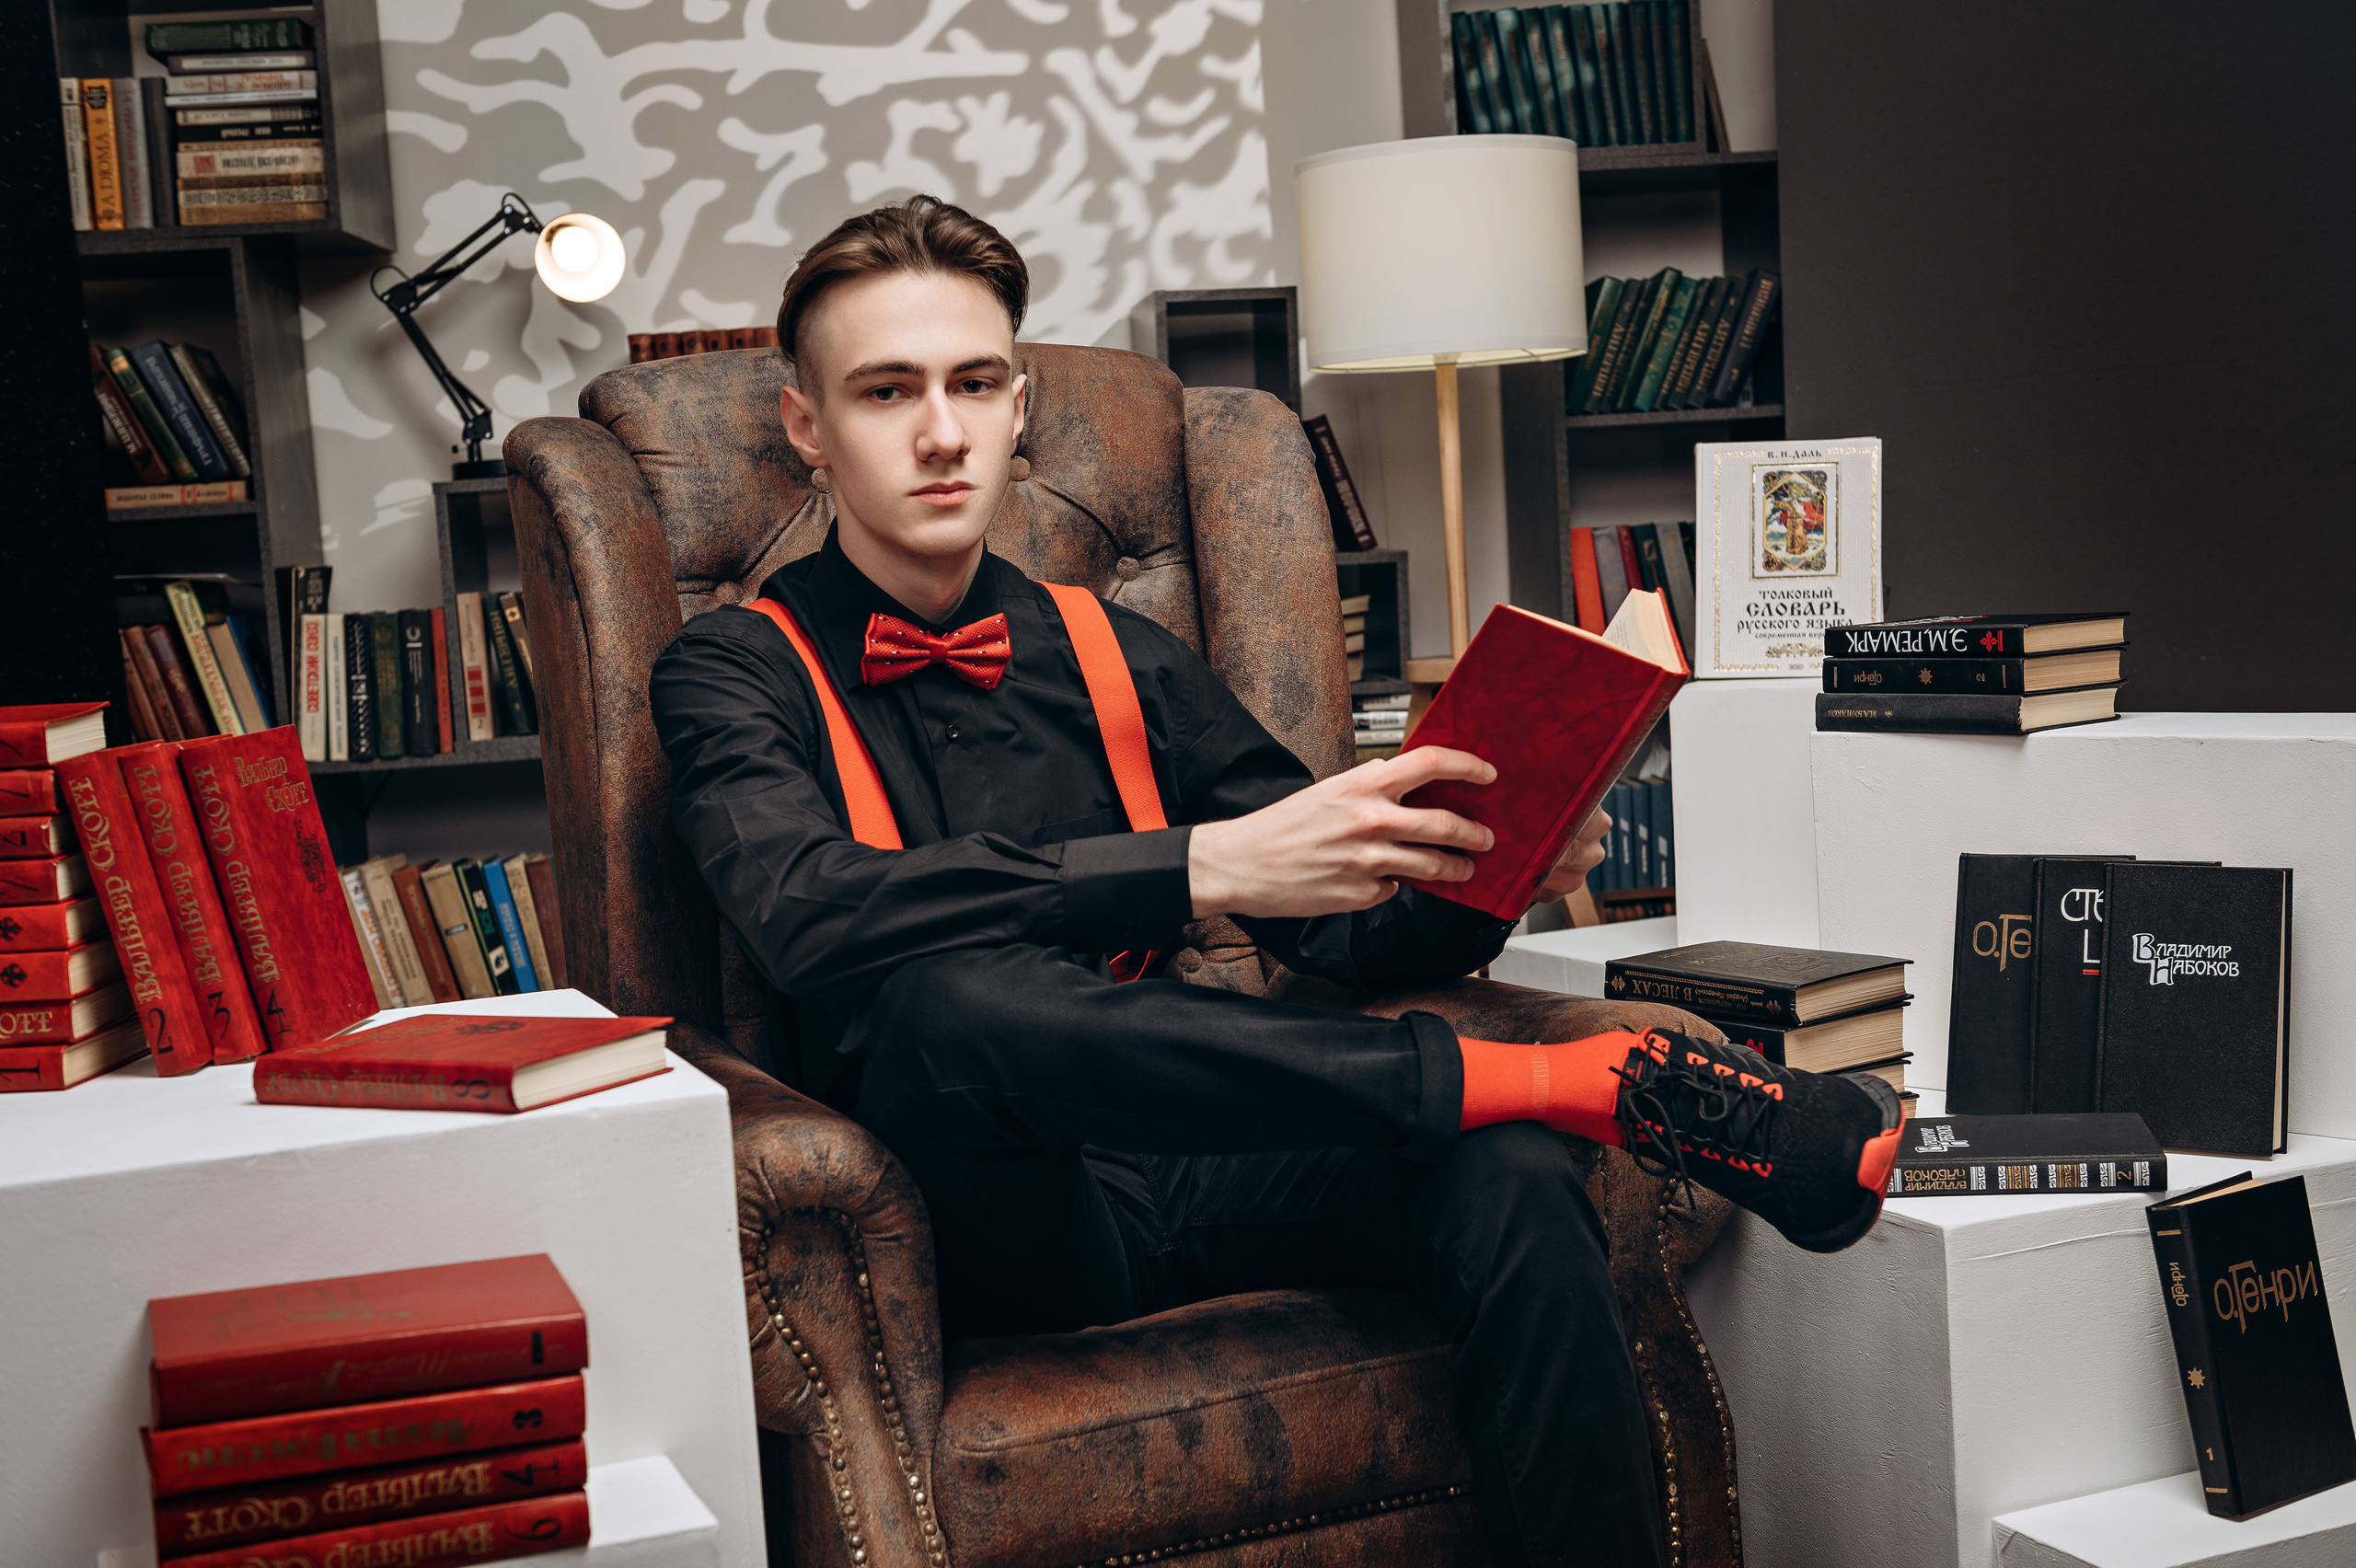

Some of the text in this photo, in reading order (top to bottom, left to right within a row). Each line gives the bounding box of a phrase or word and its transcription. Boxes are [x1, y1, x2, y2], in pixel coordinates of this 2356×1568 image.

[1746, 600, 1846, 617] СЛОВАРЬ
[1976, 673, 1986, 683] 2
[192, 763, 237, 857] СКОТТ
[69, 776, 165, 1005] ВАЛЬТЕР СКОТТ
[133, 764, 222, 986] ВАЛЬТЕР СКОТТ
[225, 860, 282, 985] ВАЛЬТЕР
[2131, 932, 2233, 963] ВЛАДИМИР
[1632, 979, 1693, 1001] В ЛЕСАХ
[2150, 955, 2240, 986] НАБОКОВ
[206, 990, 232, 1041] 3
[265, 987, 294, 1034] 4
[147, 1007, 174, 1055] 2
[1905, 1180, 1968, 1192] ВЛАДИМИР
[2117, 1170, 2132, 1182] 2
[2206, 1447, 2214, 1461] 1
[184, 1461, 493, 1541] ВАЛЬТЕР СКОТТ
